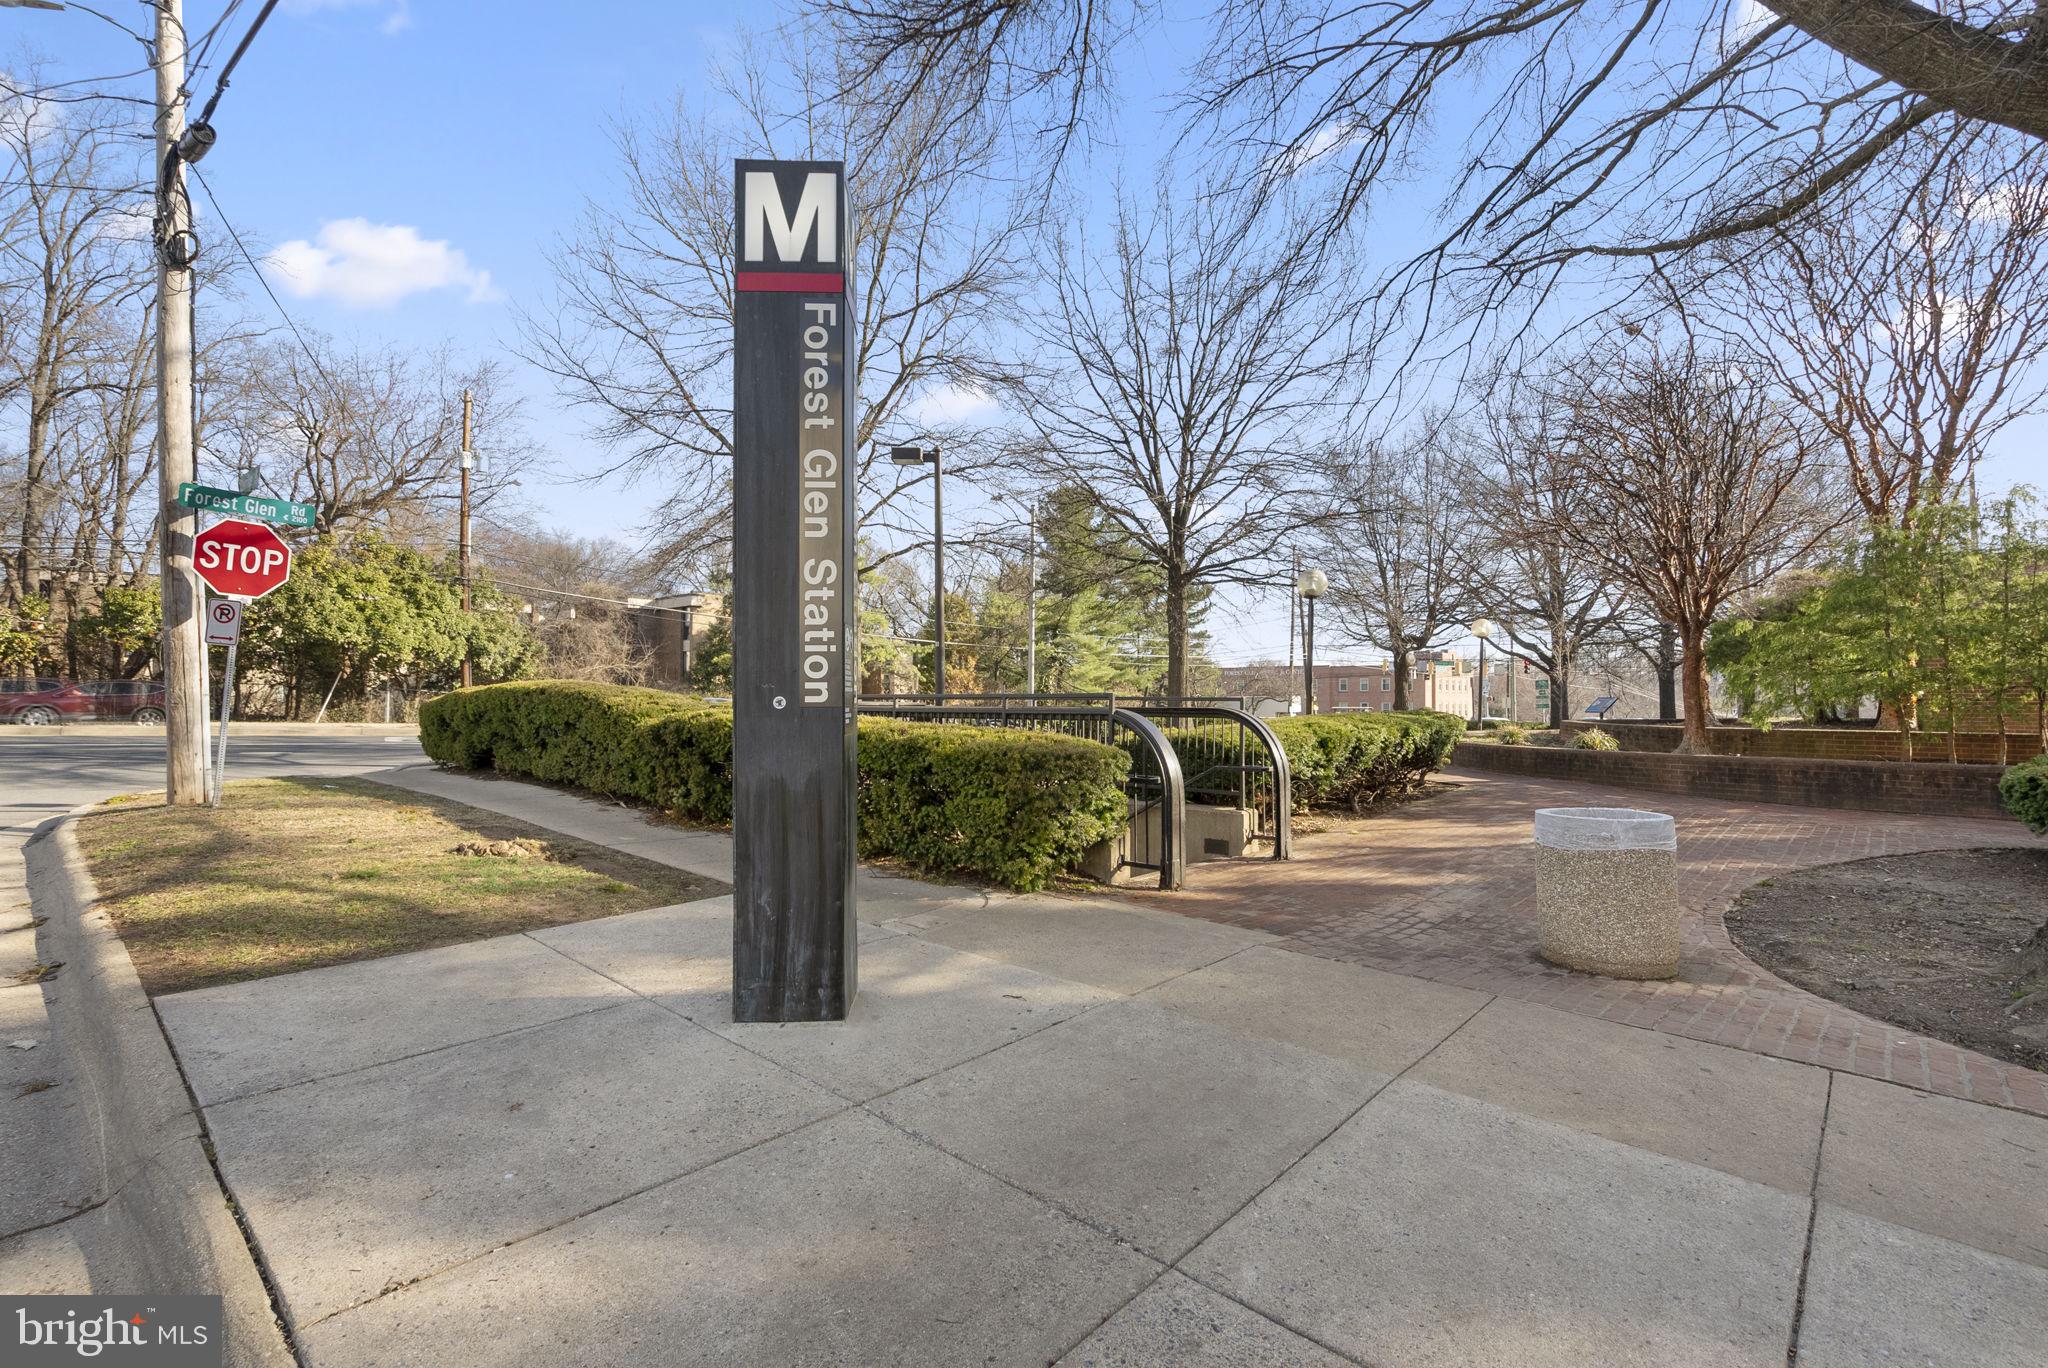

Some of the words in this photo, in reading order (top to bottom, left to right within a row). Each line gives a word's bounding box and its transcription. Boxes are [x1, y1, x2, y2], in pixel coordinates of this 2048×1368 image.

[744, 171, 837, 263] M
[803, 302, 837, 430] Forest
[184, 487, 238, 511] Forest
[244, 499, 277, 518] Glen
[291, 505, 306, 517] Rd
[803, 448, 838, 538] Glen
[199, 540, 284, 576] STOP
[803, 558, 838, 703] Station
